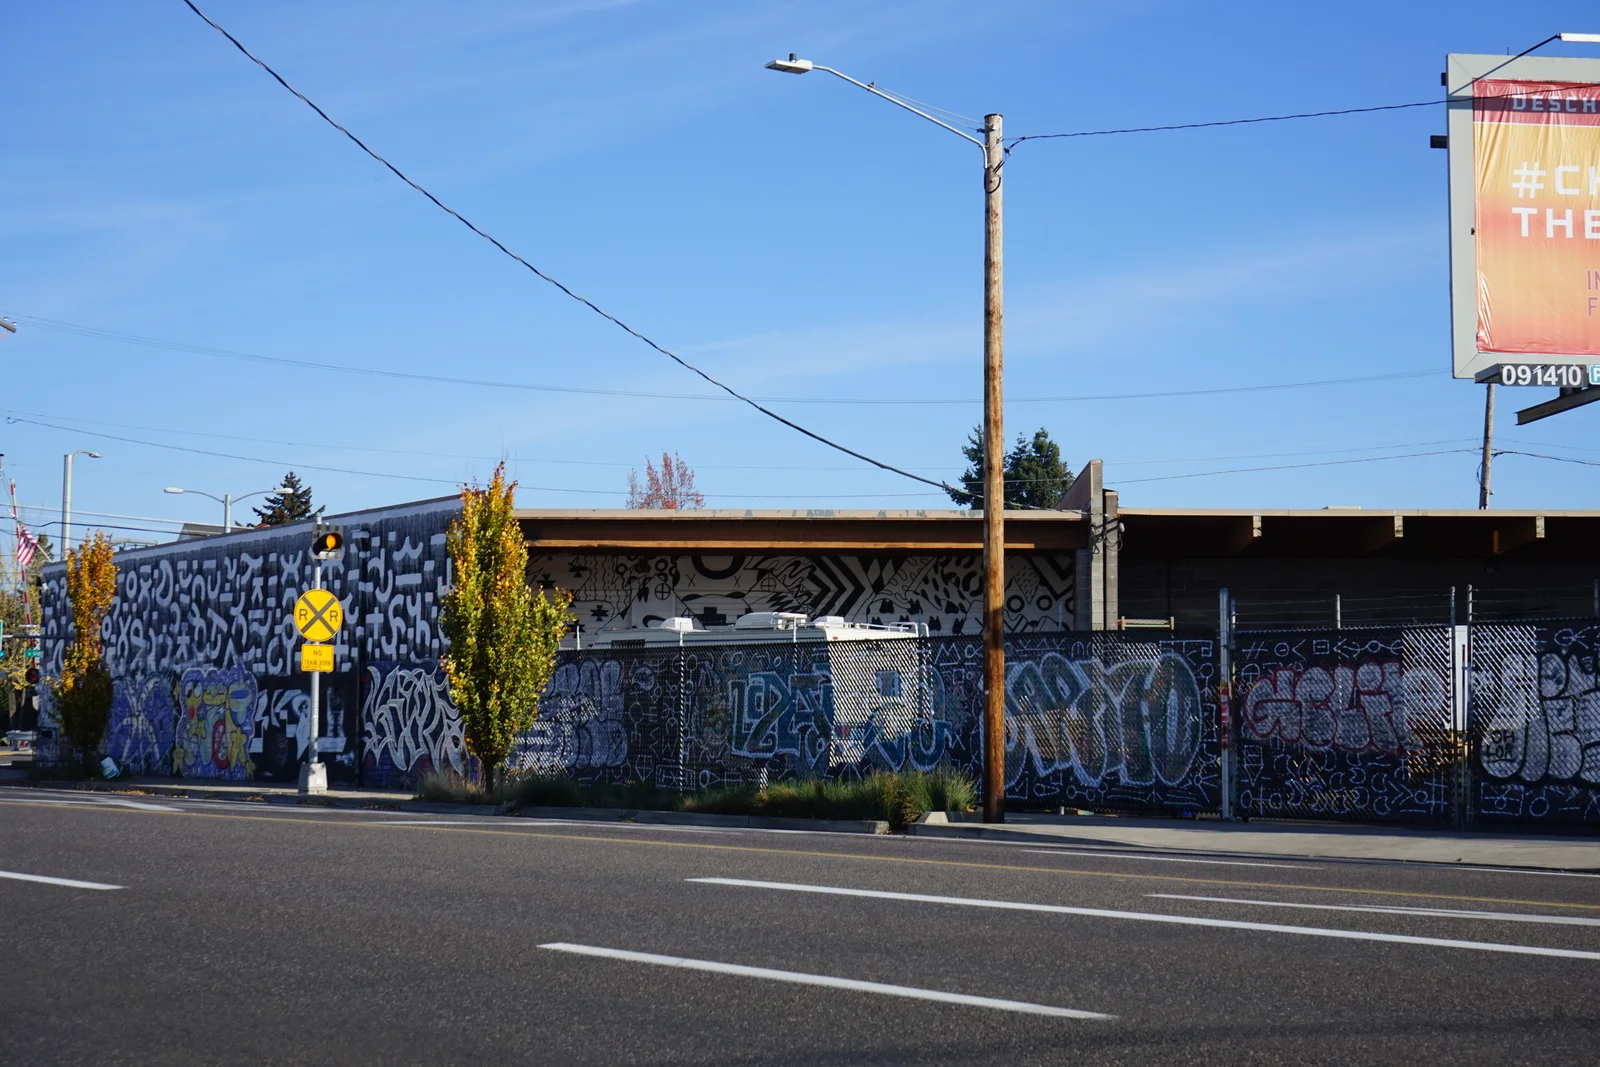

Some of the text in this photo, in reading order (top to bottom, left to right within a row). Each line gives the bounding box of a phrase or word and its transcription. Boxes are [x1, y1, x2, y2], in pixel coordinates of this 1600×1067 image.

[1511, 207, 1600, 239] THE
[1502, 364, 1581, 386] 091410
[313, 649, 323, 657] NO
